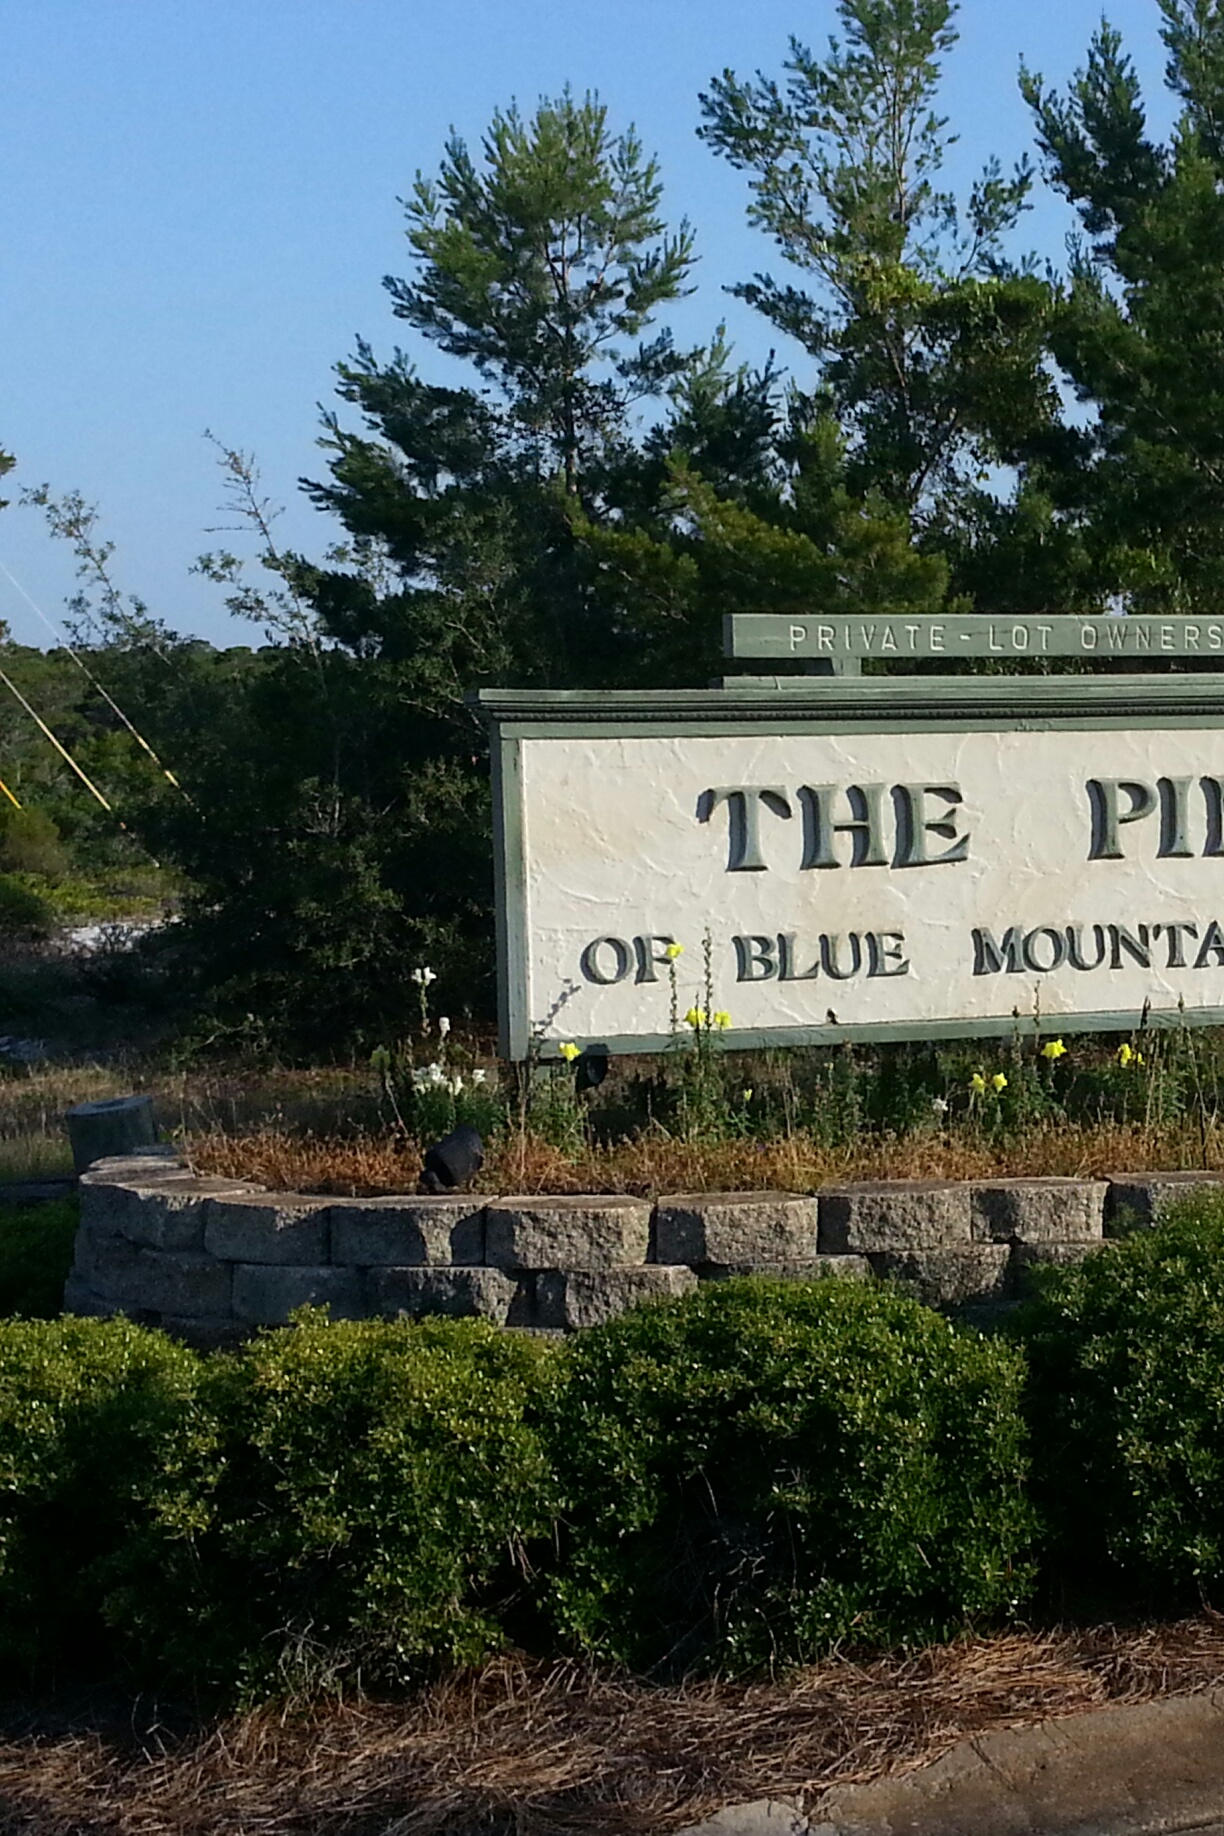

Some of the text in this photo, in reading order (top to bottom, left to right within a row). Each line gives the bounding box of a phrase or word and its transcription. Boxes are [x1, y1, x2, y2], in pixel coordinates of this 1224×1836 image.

[1080, 624, 1224, 650] OWNERS
[696, 781, 971, 872] THE
[580, 933, 674, 986] OF
[731, 931, 911, 983] BLUE
